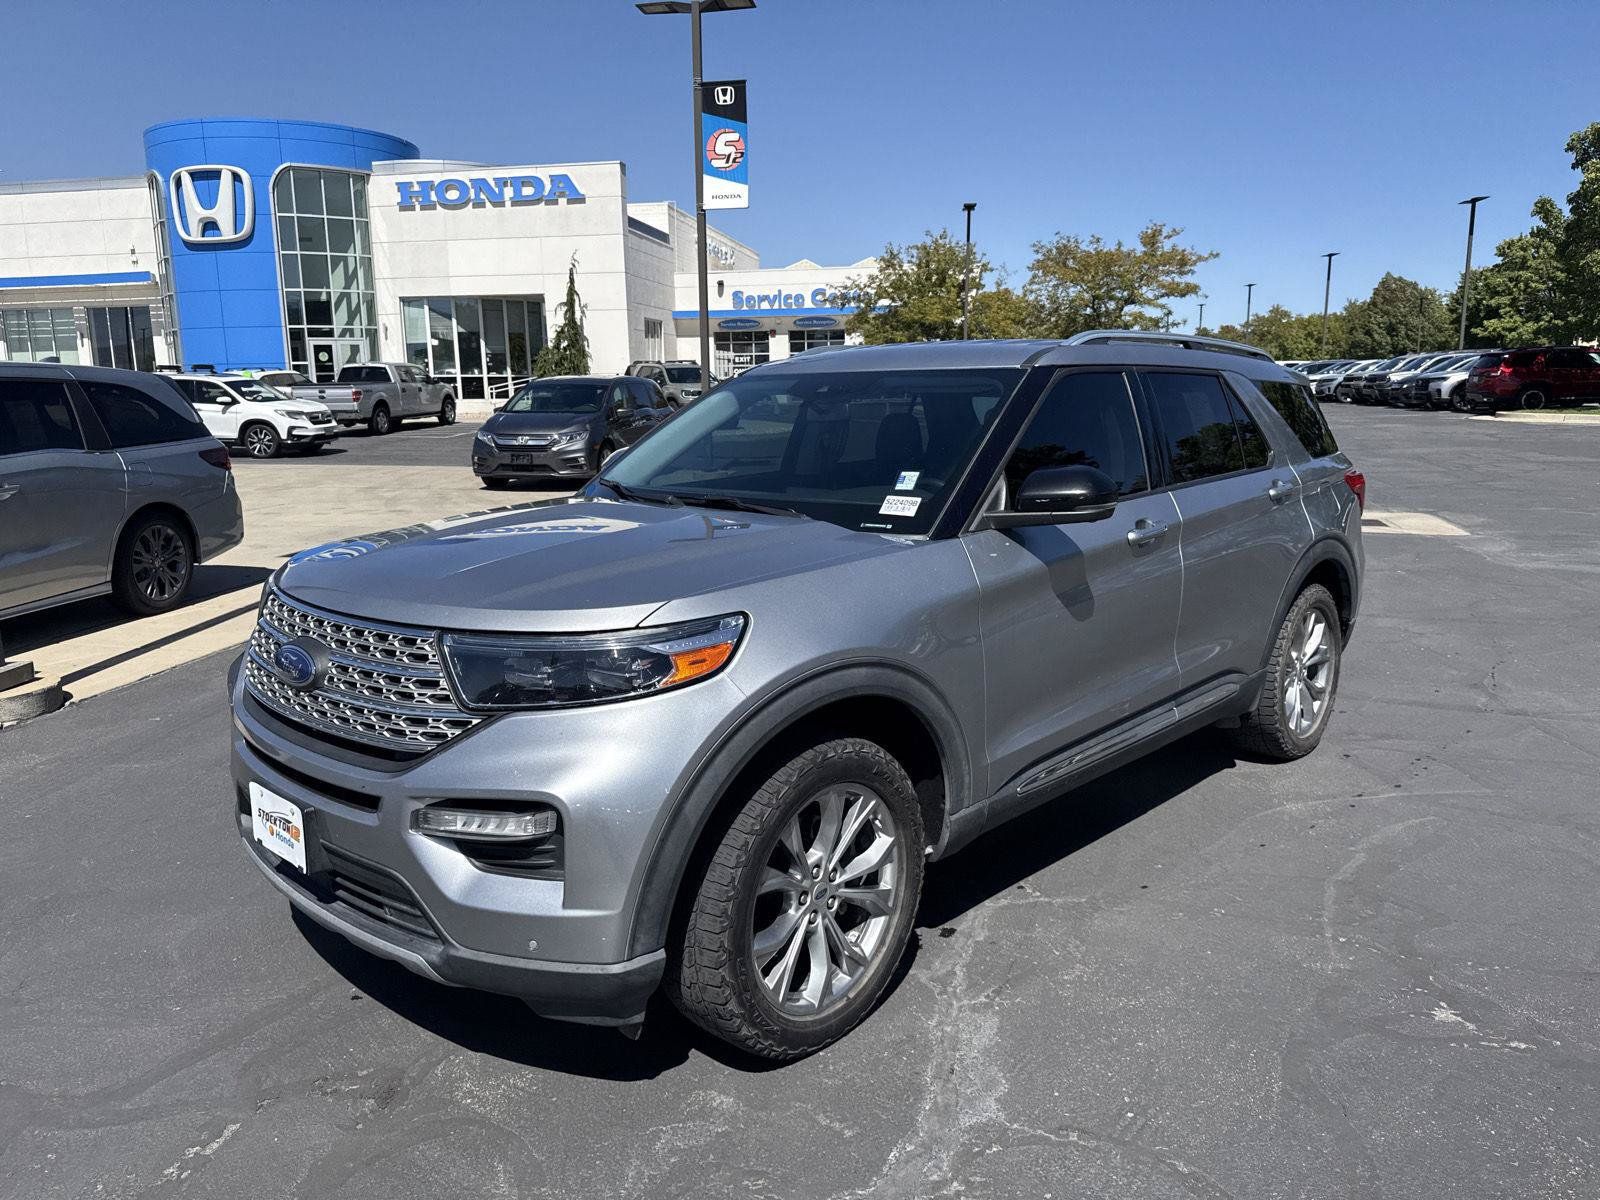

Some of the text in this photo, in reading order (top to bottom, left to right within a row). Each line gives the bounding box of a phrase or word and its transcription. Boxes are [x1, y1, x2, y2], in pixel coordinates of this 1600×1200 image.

[395, 174, 586, 210] HONDA
[732, 289, 805, 309] Service
[257, 807, 291, 835] STOCKTON
[275, 829, 295, 849] Honda
